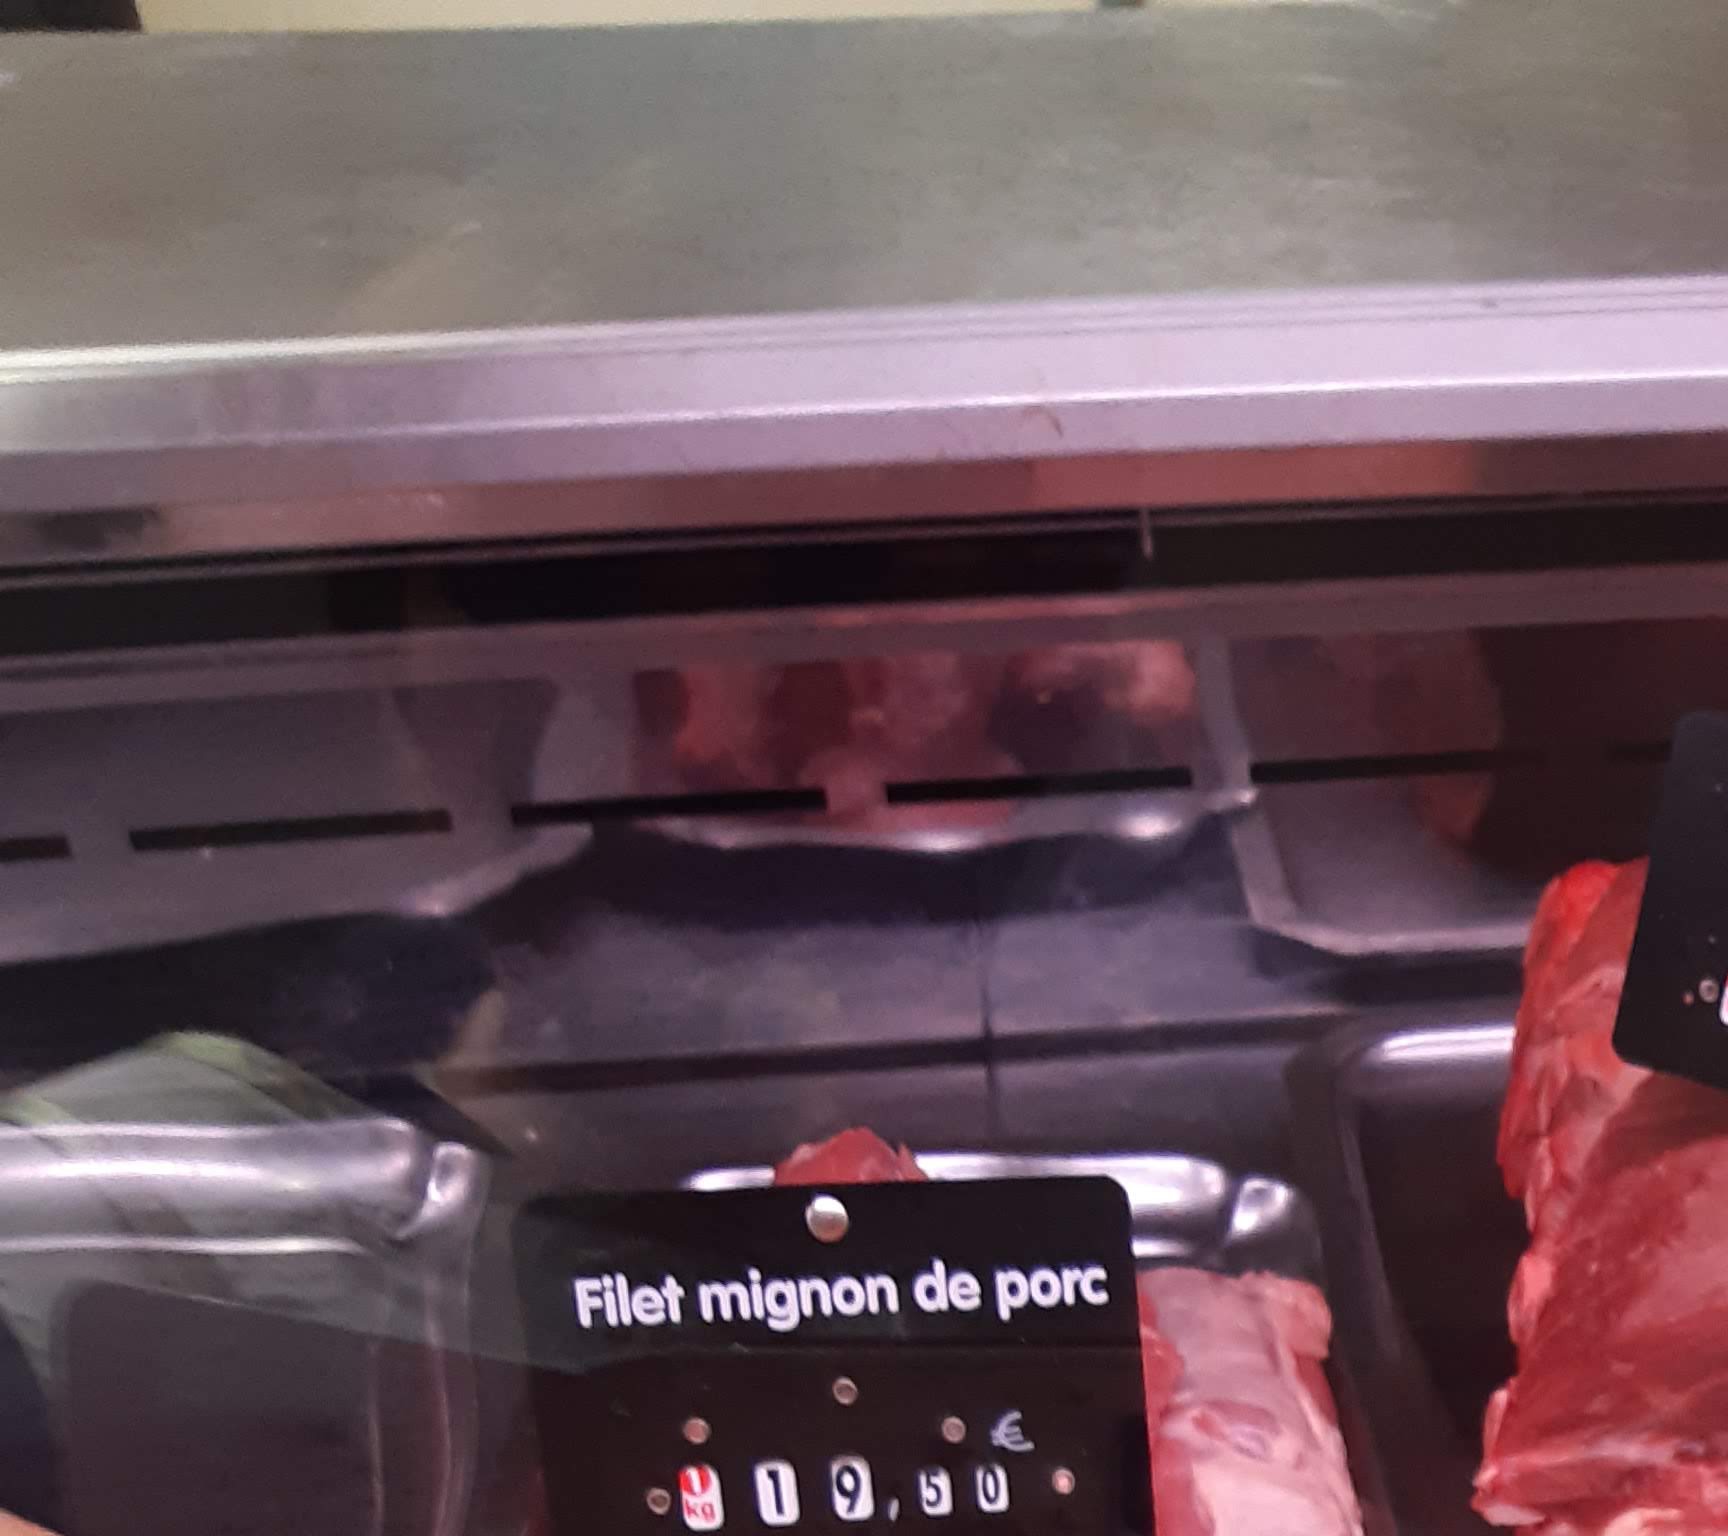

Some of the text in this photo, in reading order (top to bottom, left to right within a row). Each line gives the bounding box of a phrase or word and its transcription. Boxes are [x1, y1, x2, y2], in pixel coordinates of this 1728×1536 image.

[573, 1257, 1109, 1331] Filet mignon de porc
[991, 1410, 1035, 1453] €
[762, 1461, 1003, 1523] 19,50
